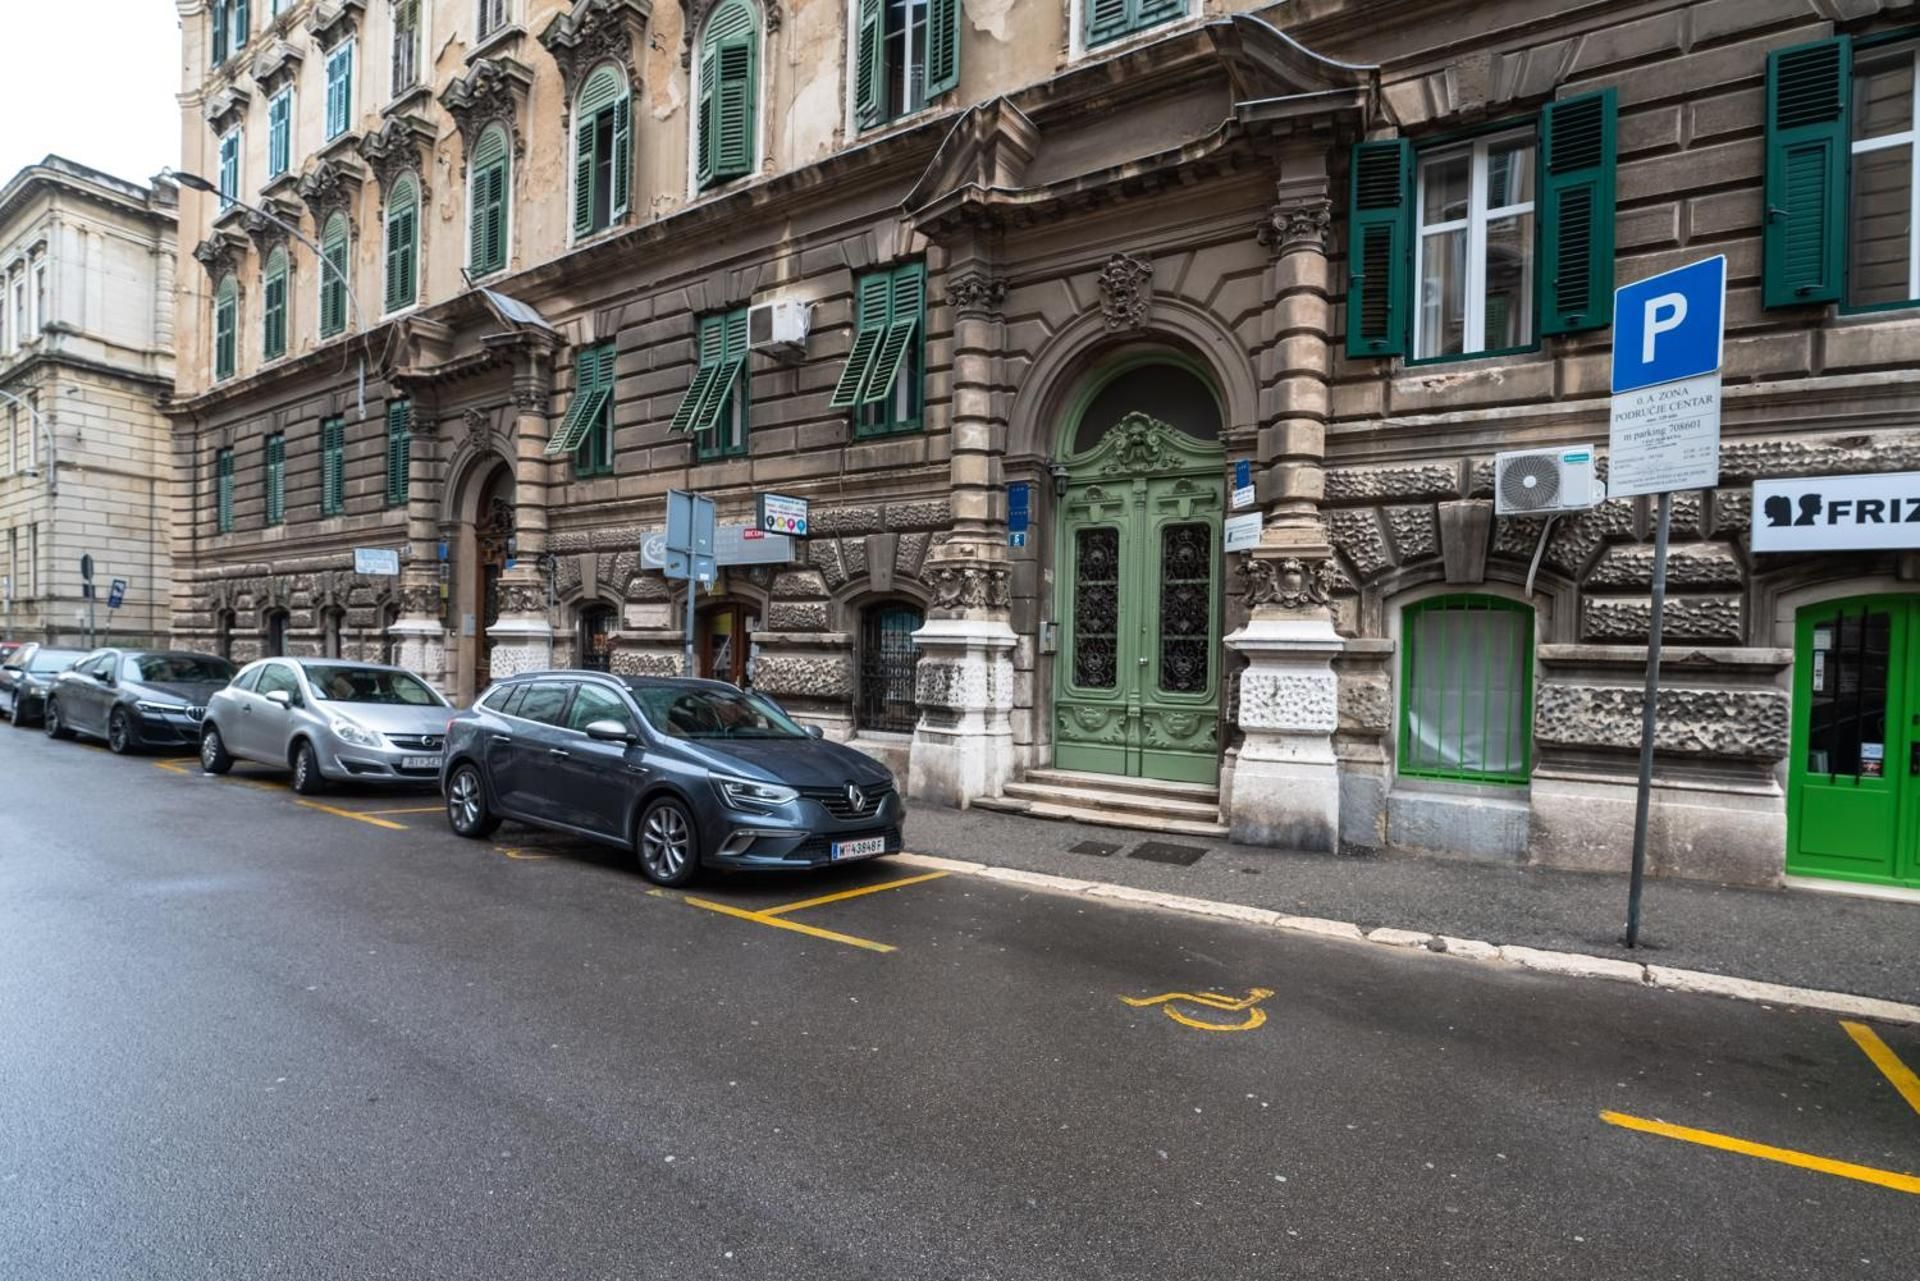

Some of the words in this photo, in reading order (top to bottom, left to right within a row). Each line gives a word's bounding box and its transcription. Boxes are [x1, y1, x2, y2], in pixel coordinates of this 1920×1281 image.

[1642, 292, 1688, 364] P
[1659, 387, 1689, 401] ZONA
[1669, 394, 1713, 411] CENTAR
[1623, 433, 1632, 441] m
[1634, 426, 1667, 441] parking
[1668, 419, 1701, 433] 708601
